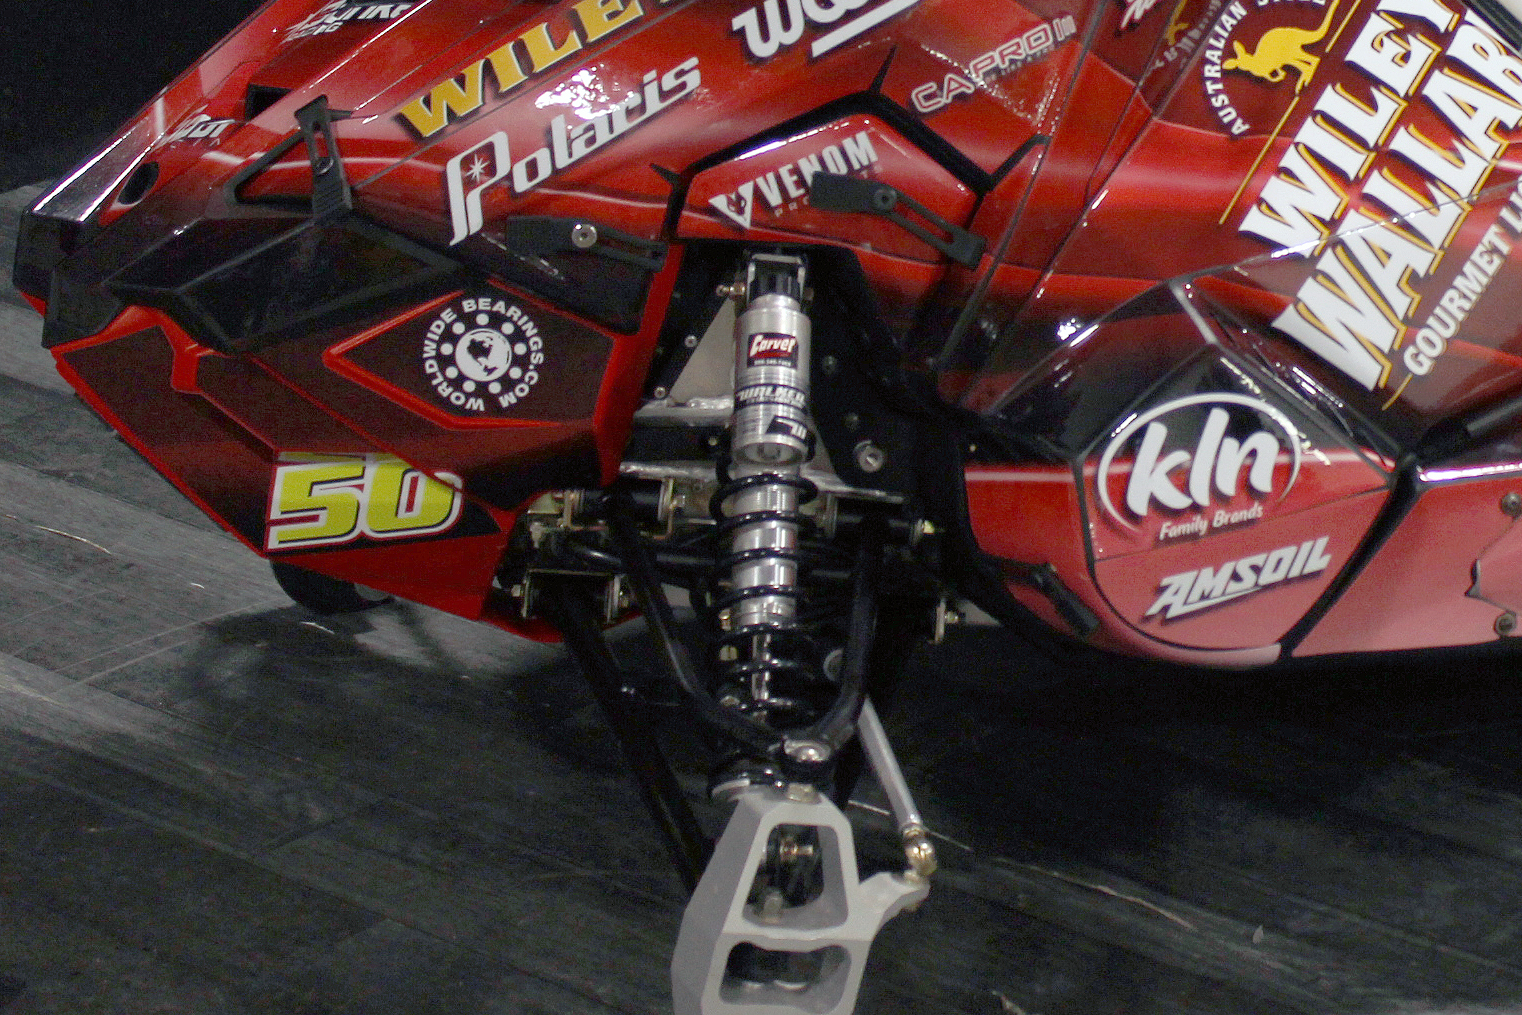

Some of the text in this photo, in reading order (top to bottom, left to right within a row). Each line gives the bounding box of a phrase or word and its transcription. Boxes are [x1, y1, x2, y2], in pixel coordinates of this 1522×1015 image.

[1203, 1, 1250, 138] AUSTRALIAN
[446, 56, 701, 246] Polaris
[756, 130, 879, 207] VENOM
[422, 297, 544, 411] WORLDWIDE BEARINGS.COM
[749, 334, 797, 357] Carver
[1403, 225, 1514, 378] GOURMET
[265, 451, 463, 553] 50
[1126, 407, 1280, 516] kln
[1159, 501, 1263, 540] Family Brands
[1144, 536, 1332, 620] AMSOIL
